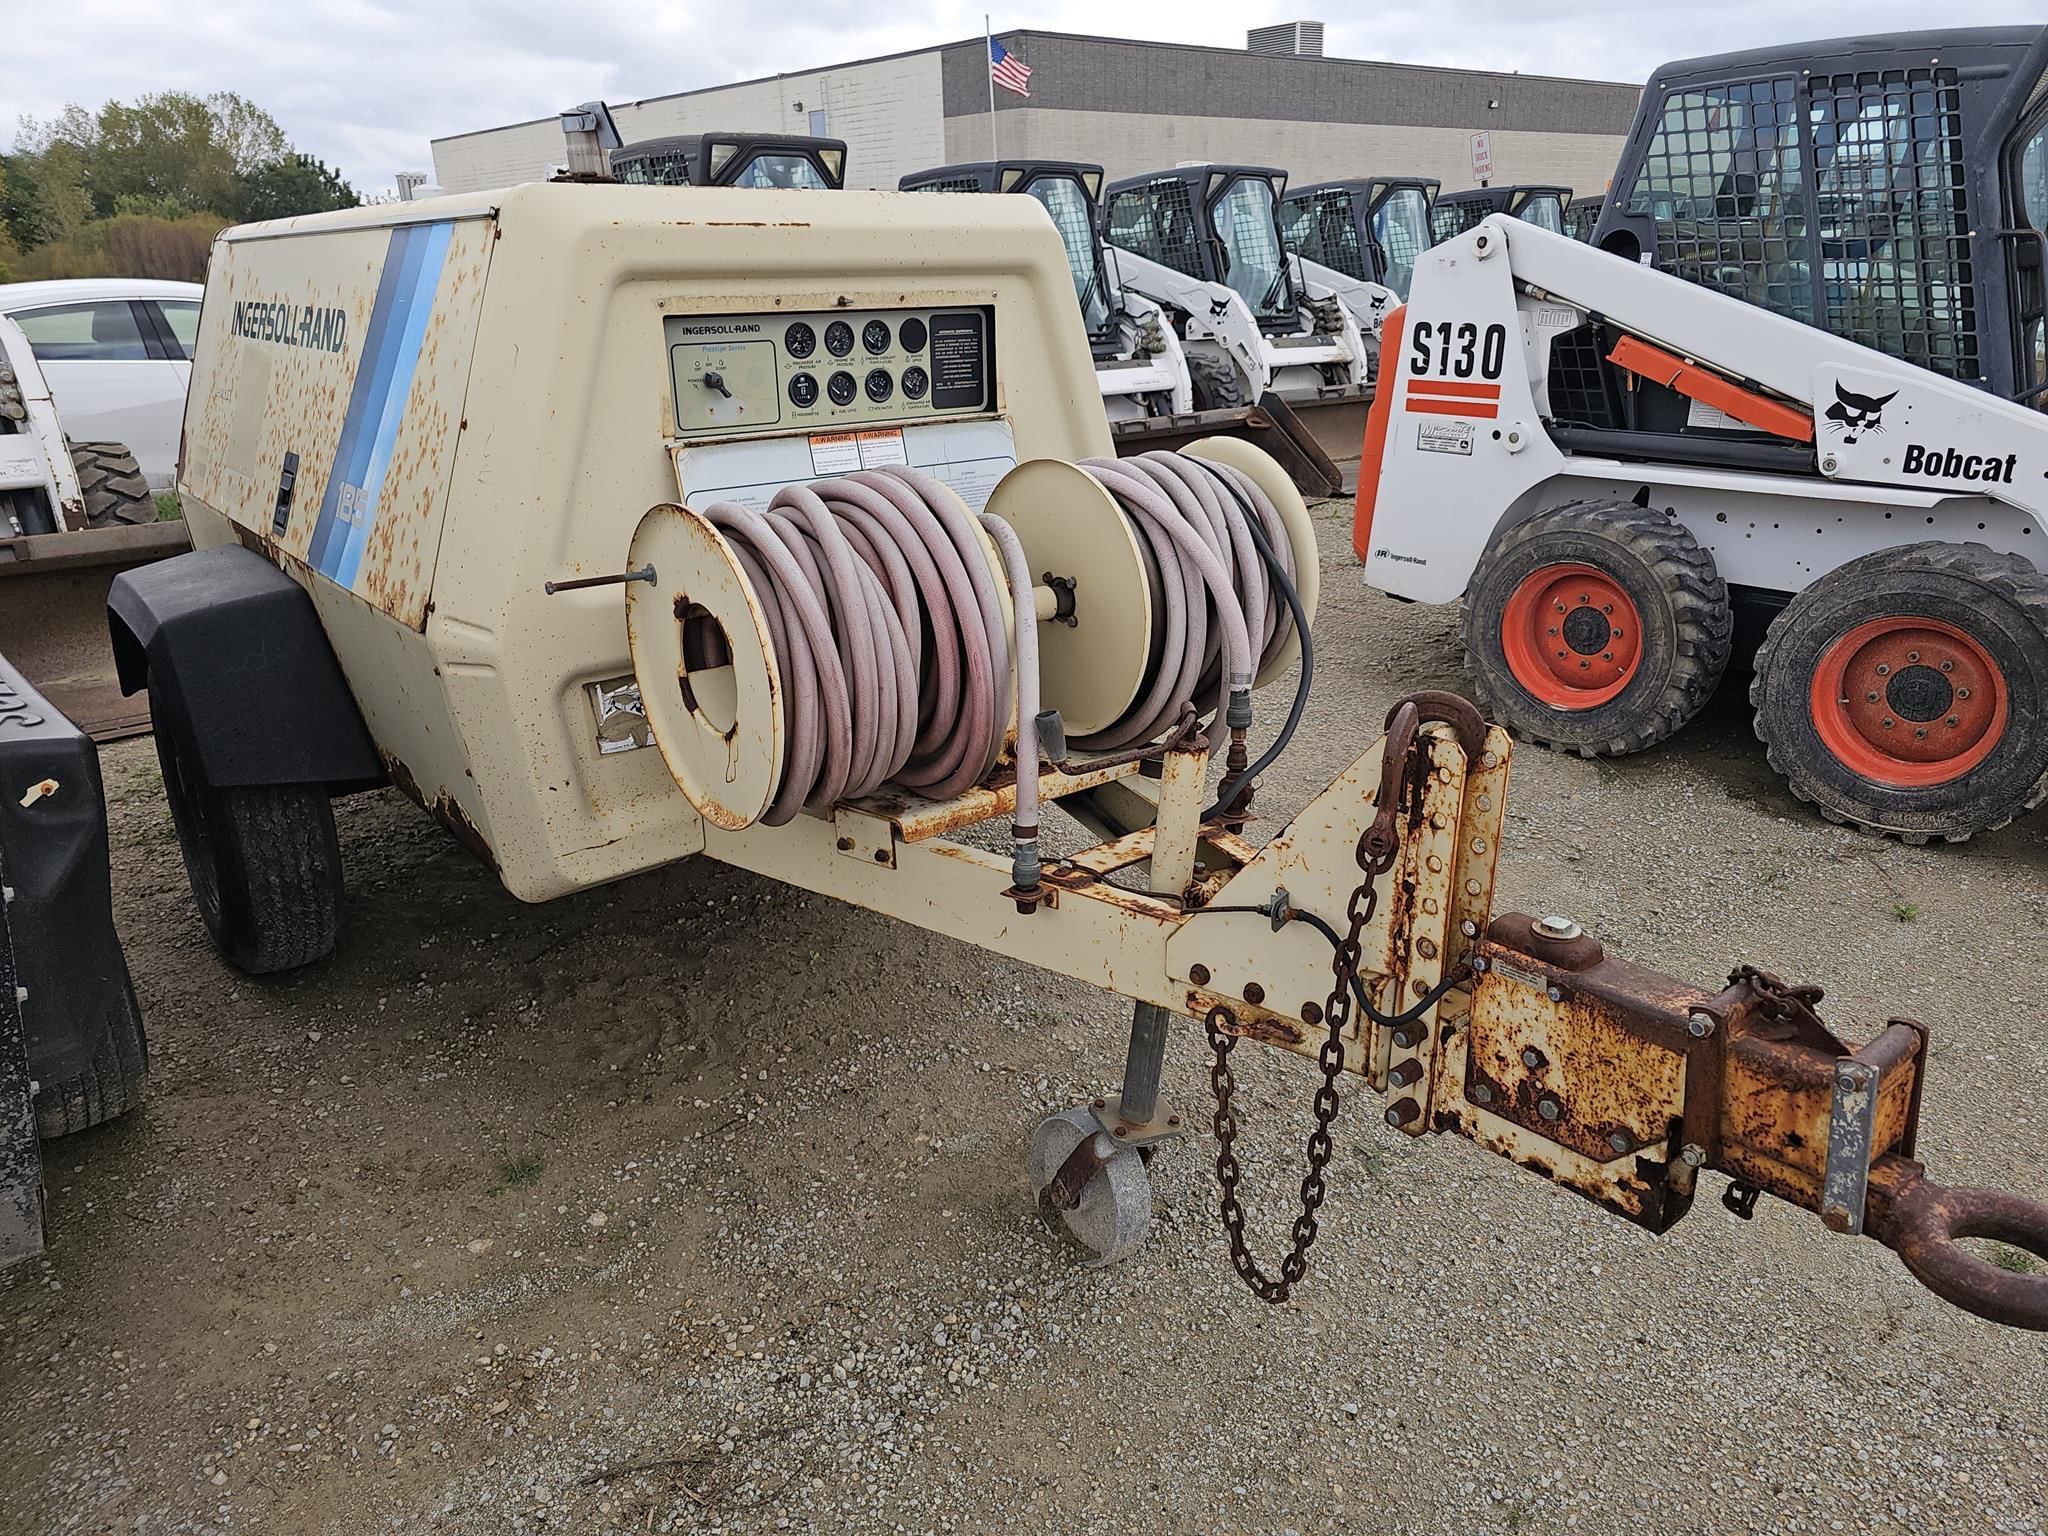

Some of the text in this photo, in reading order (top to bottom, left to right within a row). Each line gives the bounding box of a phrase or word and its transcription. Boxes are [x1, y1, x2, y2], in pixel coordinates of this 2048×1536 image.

[1474, 151, 1488, 162] TRUCK
[1473, 163, 1491, 175] PARKING
[231, 301, 346, 353] INGERSOLL-RAND
[682, 324, 761, 335] INGERSOLL-RAND
[1411, 321, 1506, 380] S130
[819, 434, 851, 444] WARNING
[868, 430, 897, 440] WARNING
[1902, 444, 2017, 484] Bobcat
[335, 481, 369, 529] 185
